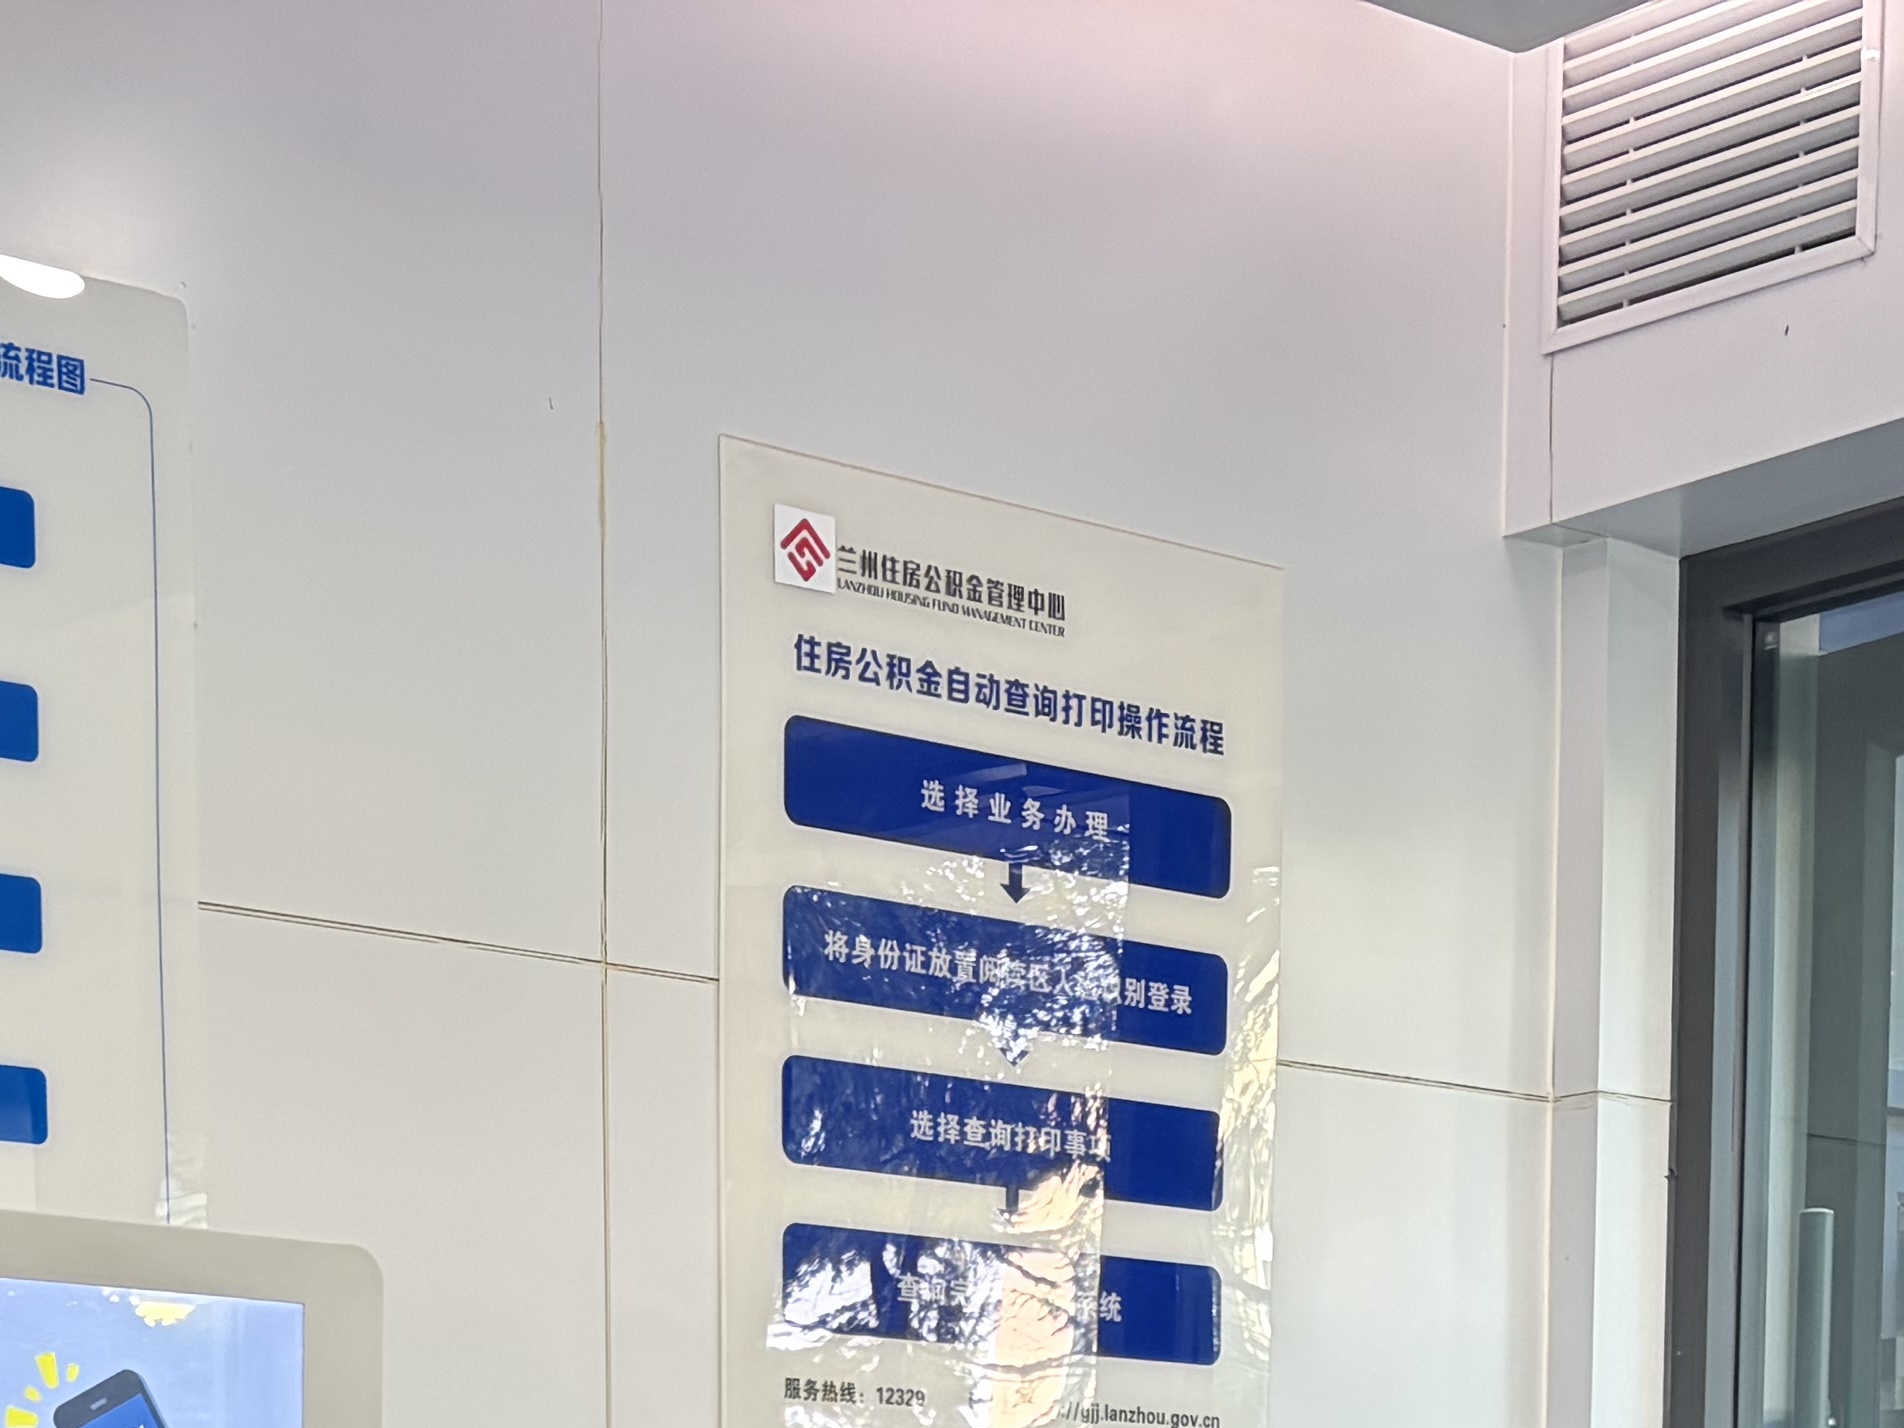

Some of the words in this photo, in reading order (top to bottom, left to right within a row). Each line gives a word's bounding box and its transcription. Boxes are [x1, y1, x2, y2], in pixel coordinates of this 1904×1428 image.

[836, 545, 1066, 622] 兰州住房公积金管理中心
[794, 633, 1225, 756] 住房公积金自动查询打印操作流程
[920, 779, 1110, 841] 选择业务办理
[910, 1110, 1112, 1162] 选择查询打印事项
